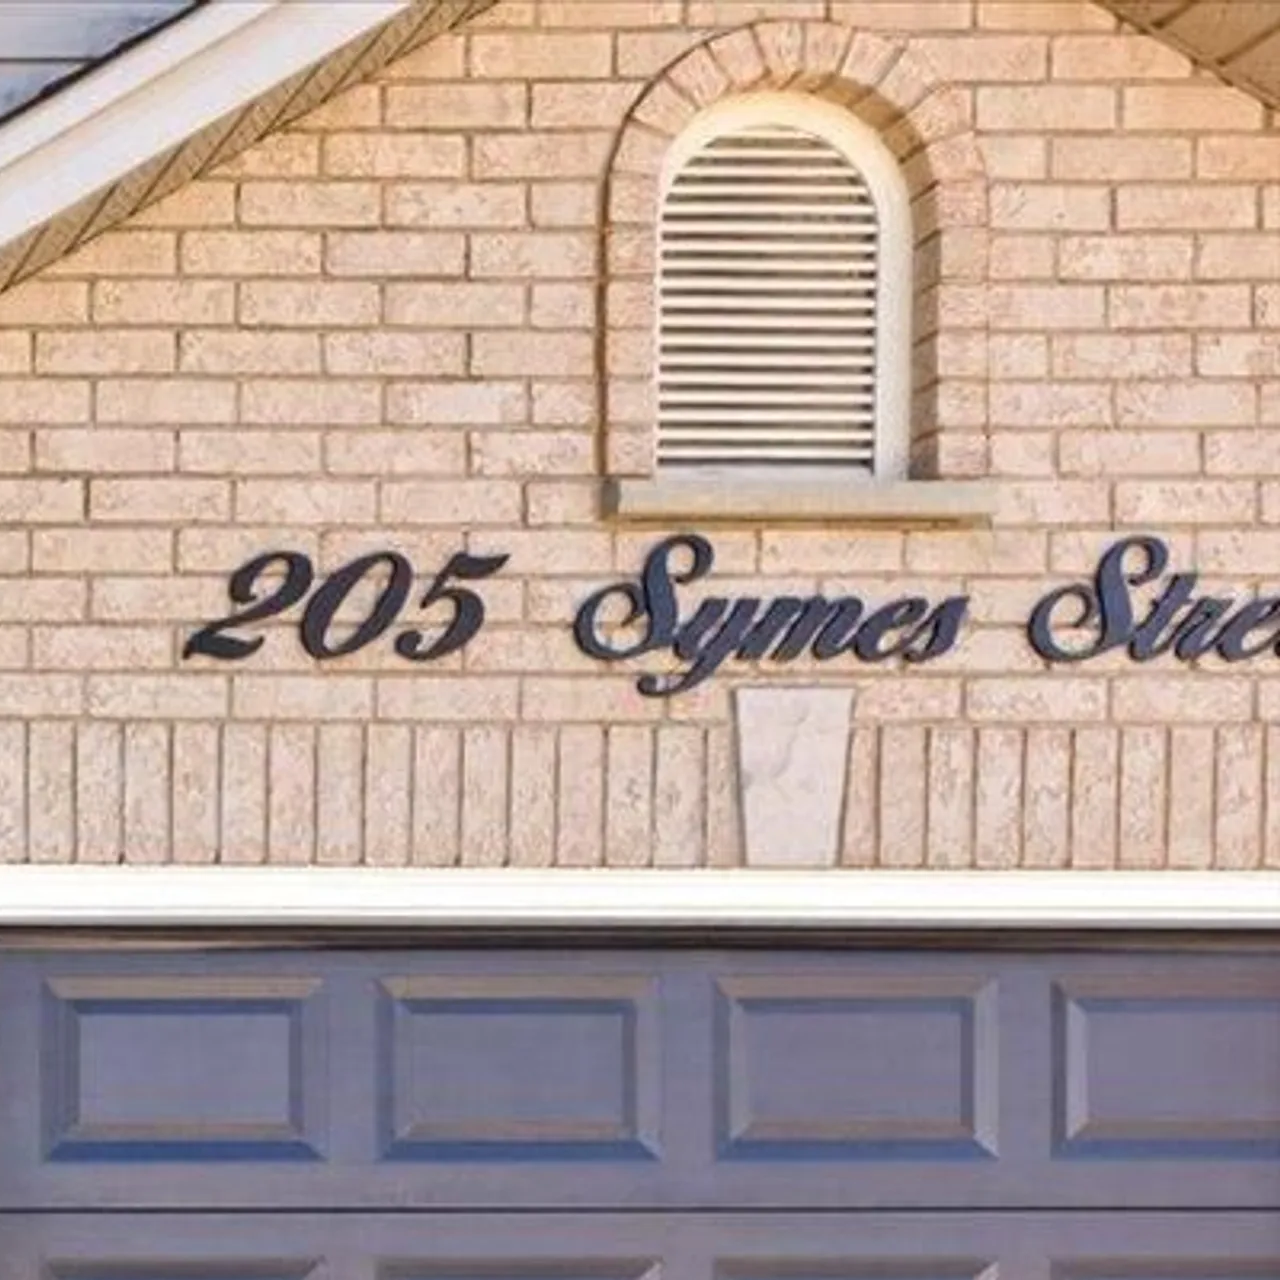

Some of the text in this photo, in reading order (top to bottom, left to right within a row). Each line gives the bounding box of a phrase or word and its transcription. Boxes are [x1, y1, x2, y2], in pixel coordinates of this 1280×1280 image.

[182, 533, 1280, 697] 205 Symes Stre
